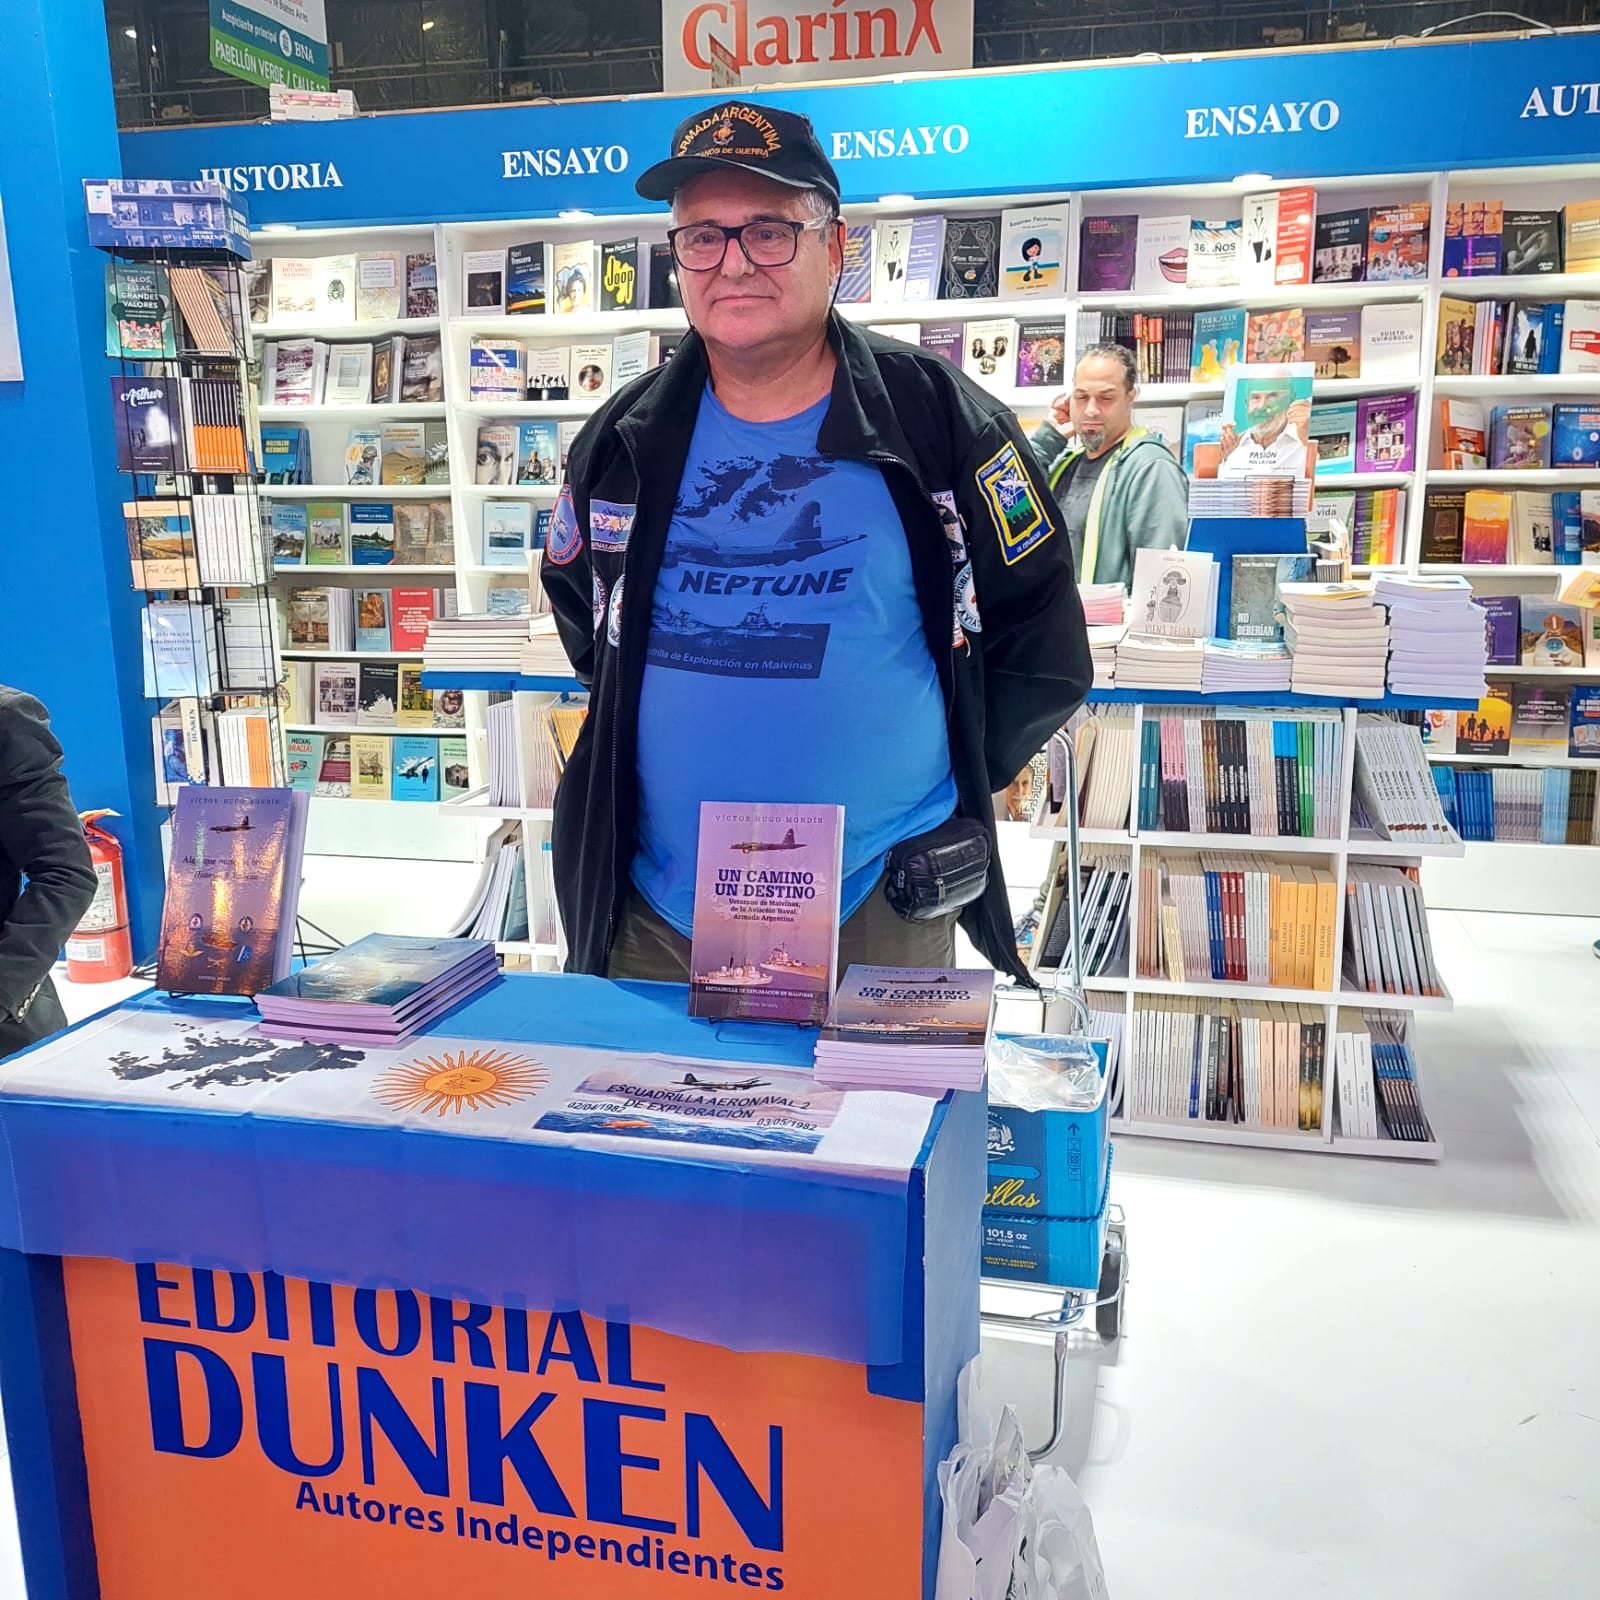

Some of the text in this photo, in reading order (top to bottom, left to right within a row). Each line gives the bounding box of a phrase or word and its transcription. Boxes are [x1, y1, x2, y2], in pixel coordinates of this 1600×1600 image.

[681, 0, 902, 70] Clarín
[294, 41, 315, 64] BNA
[215, 38, 257, 75] PABELLÓN
[258, 58, 284, 86] VERDE
[1184, 99, 1339, 138] ENSAYO
[677, 106, 782, 158] ARMADA ARGENTINA
[831, 124, 969, 160] ENSAYO
[722, 147, 733, 155] DE
[735, 147, 769, 158] GUERRA
[501, 145, 629, 180] ENSAYO
[200, 160, 344, 193] HISTORIA
[126, 275, 153, 284] ELLOS,
[121, 292, 159, 300] GRANDES
[122, 300, 158, 309] VALORES
[121, 388, 164, 407] Arthur
[1316, 506, 1337, 518] vida
[678, 567, 854, 597] NEPTUNE
[1237, 612, 1249, 624] NO
[1236, 624, 1274, 636] DEBERÍAN
[670, 651, 682, 661] de
[683, 652, 741, 670] Exploración
[744, 659, 759, 669] en
[762, 660, 814, 671] Malvinas
[715, 814, 750, 823] VÍCTOR
[755, 815, 781, 824] HUGO
[718, 869, 814, 885] UN CAMINO
[715, 883, 816, 900] UN DESTINO
[748, 906, 776, 914] Aviación
[769, 900, 801, 909] Malvinas,
[761, 915, 795, 923] Argentina
[858, 991, 971, 1001] UN DESTINO
[894, 988, 969, 996] CAMINO
[606, 1083, 811, 1111] ESCUADRILLA AERONAVAL 2
[566, 1100, 627, 1114] 02/04/1982
[623, 1098, 756, 1120] DE EXPLORACIÓN
[986, 1228, 1028, 1241] 101.5 oz
[134, 1258, 667, 1393] EDITORIAL
[142, 1336, 785, 1552] DUNKEN
[294, 1481, 786, 1592] Autores Independientes
